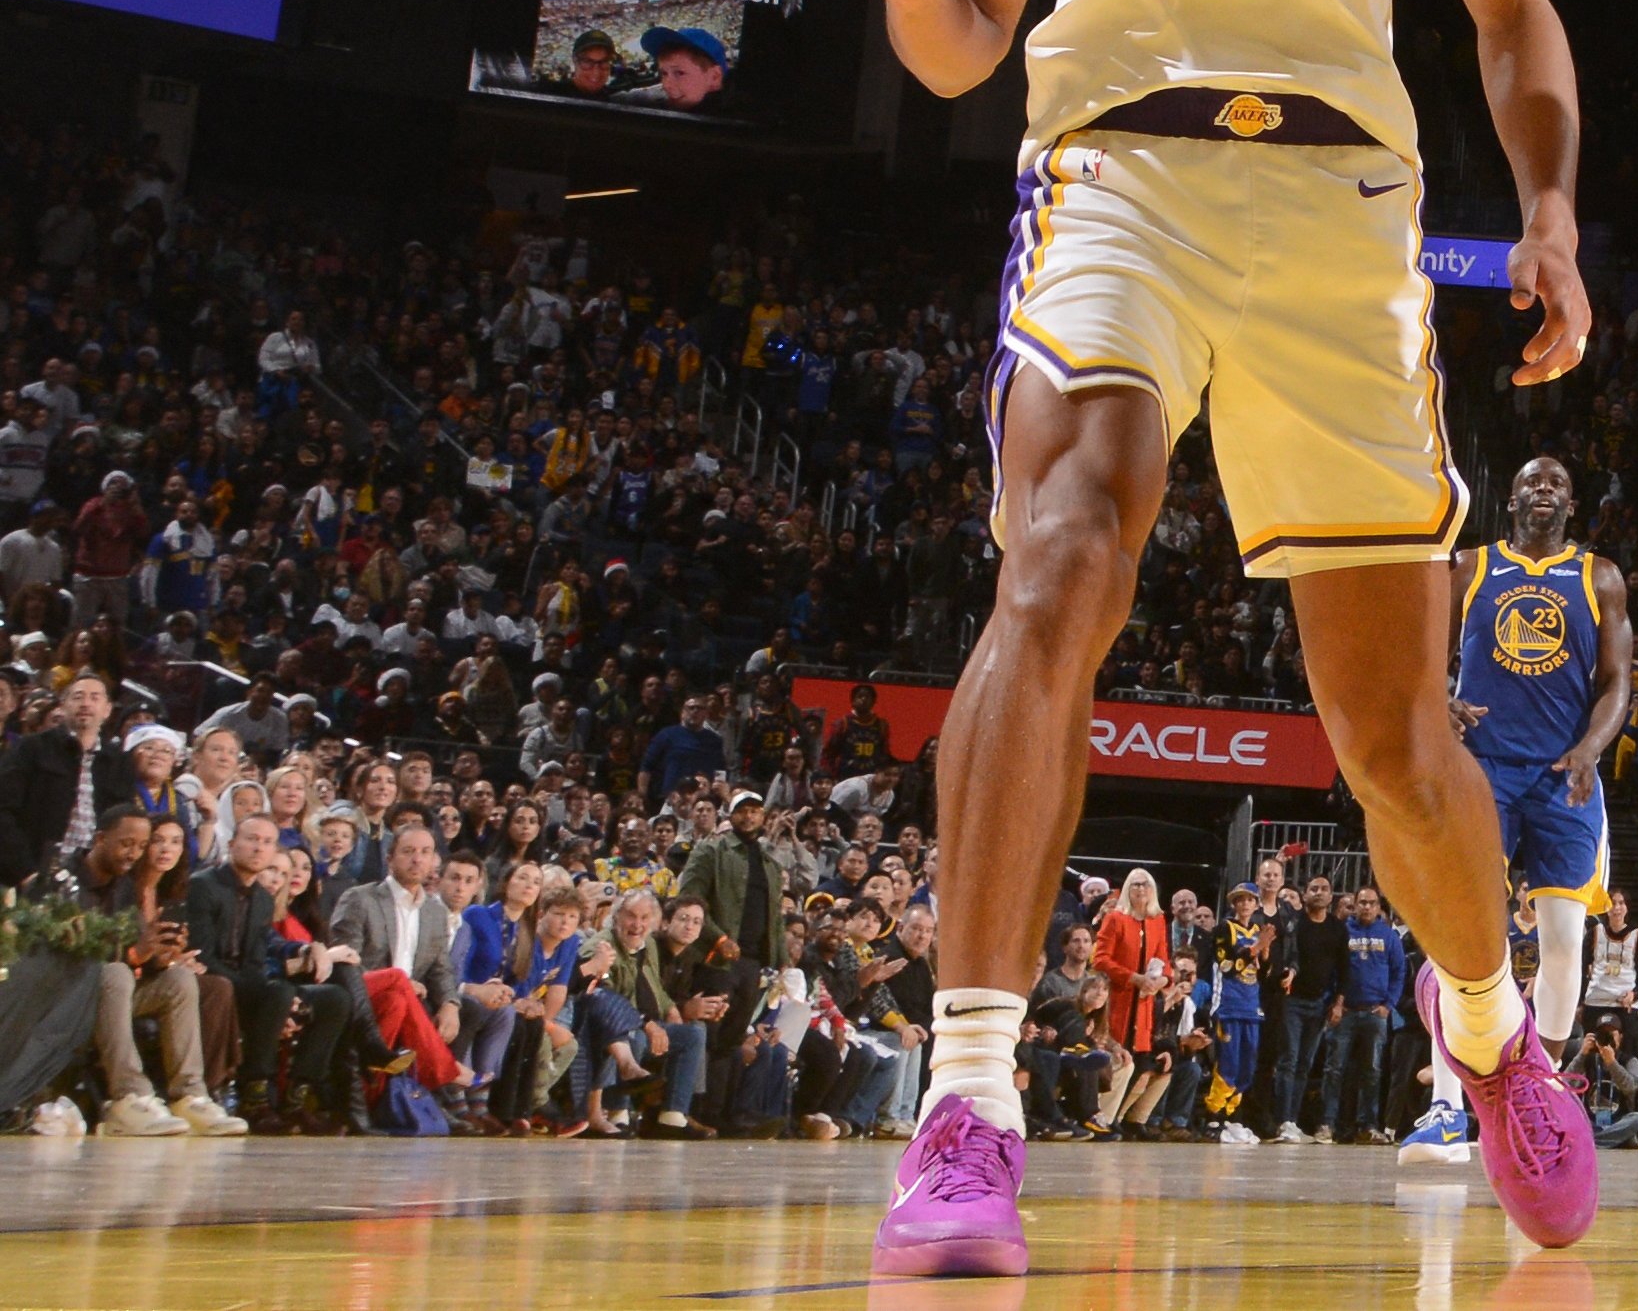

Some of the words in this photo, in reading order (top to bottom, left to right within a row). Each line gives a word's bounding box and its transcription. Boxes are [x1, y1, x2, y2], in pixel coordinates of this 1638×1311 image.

[1214, 102, 1280, 127] LAKERS
[1420, 248, 1477, 277] nity
[1495, 586, 1536, 606] GOLDEN
[1540, 586, 1569, 608] STATE
[1533, 609, 1558, 629] 23
[1493, 647, 1570, 676] WARRIORS
[1089, 718, 1269, 767] RACLE
